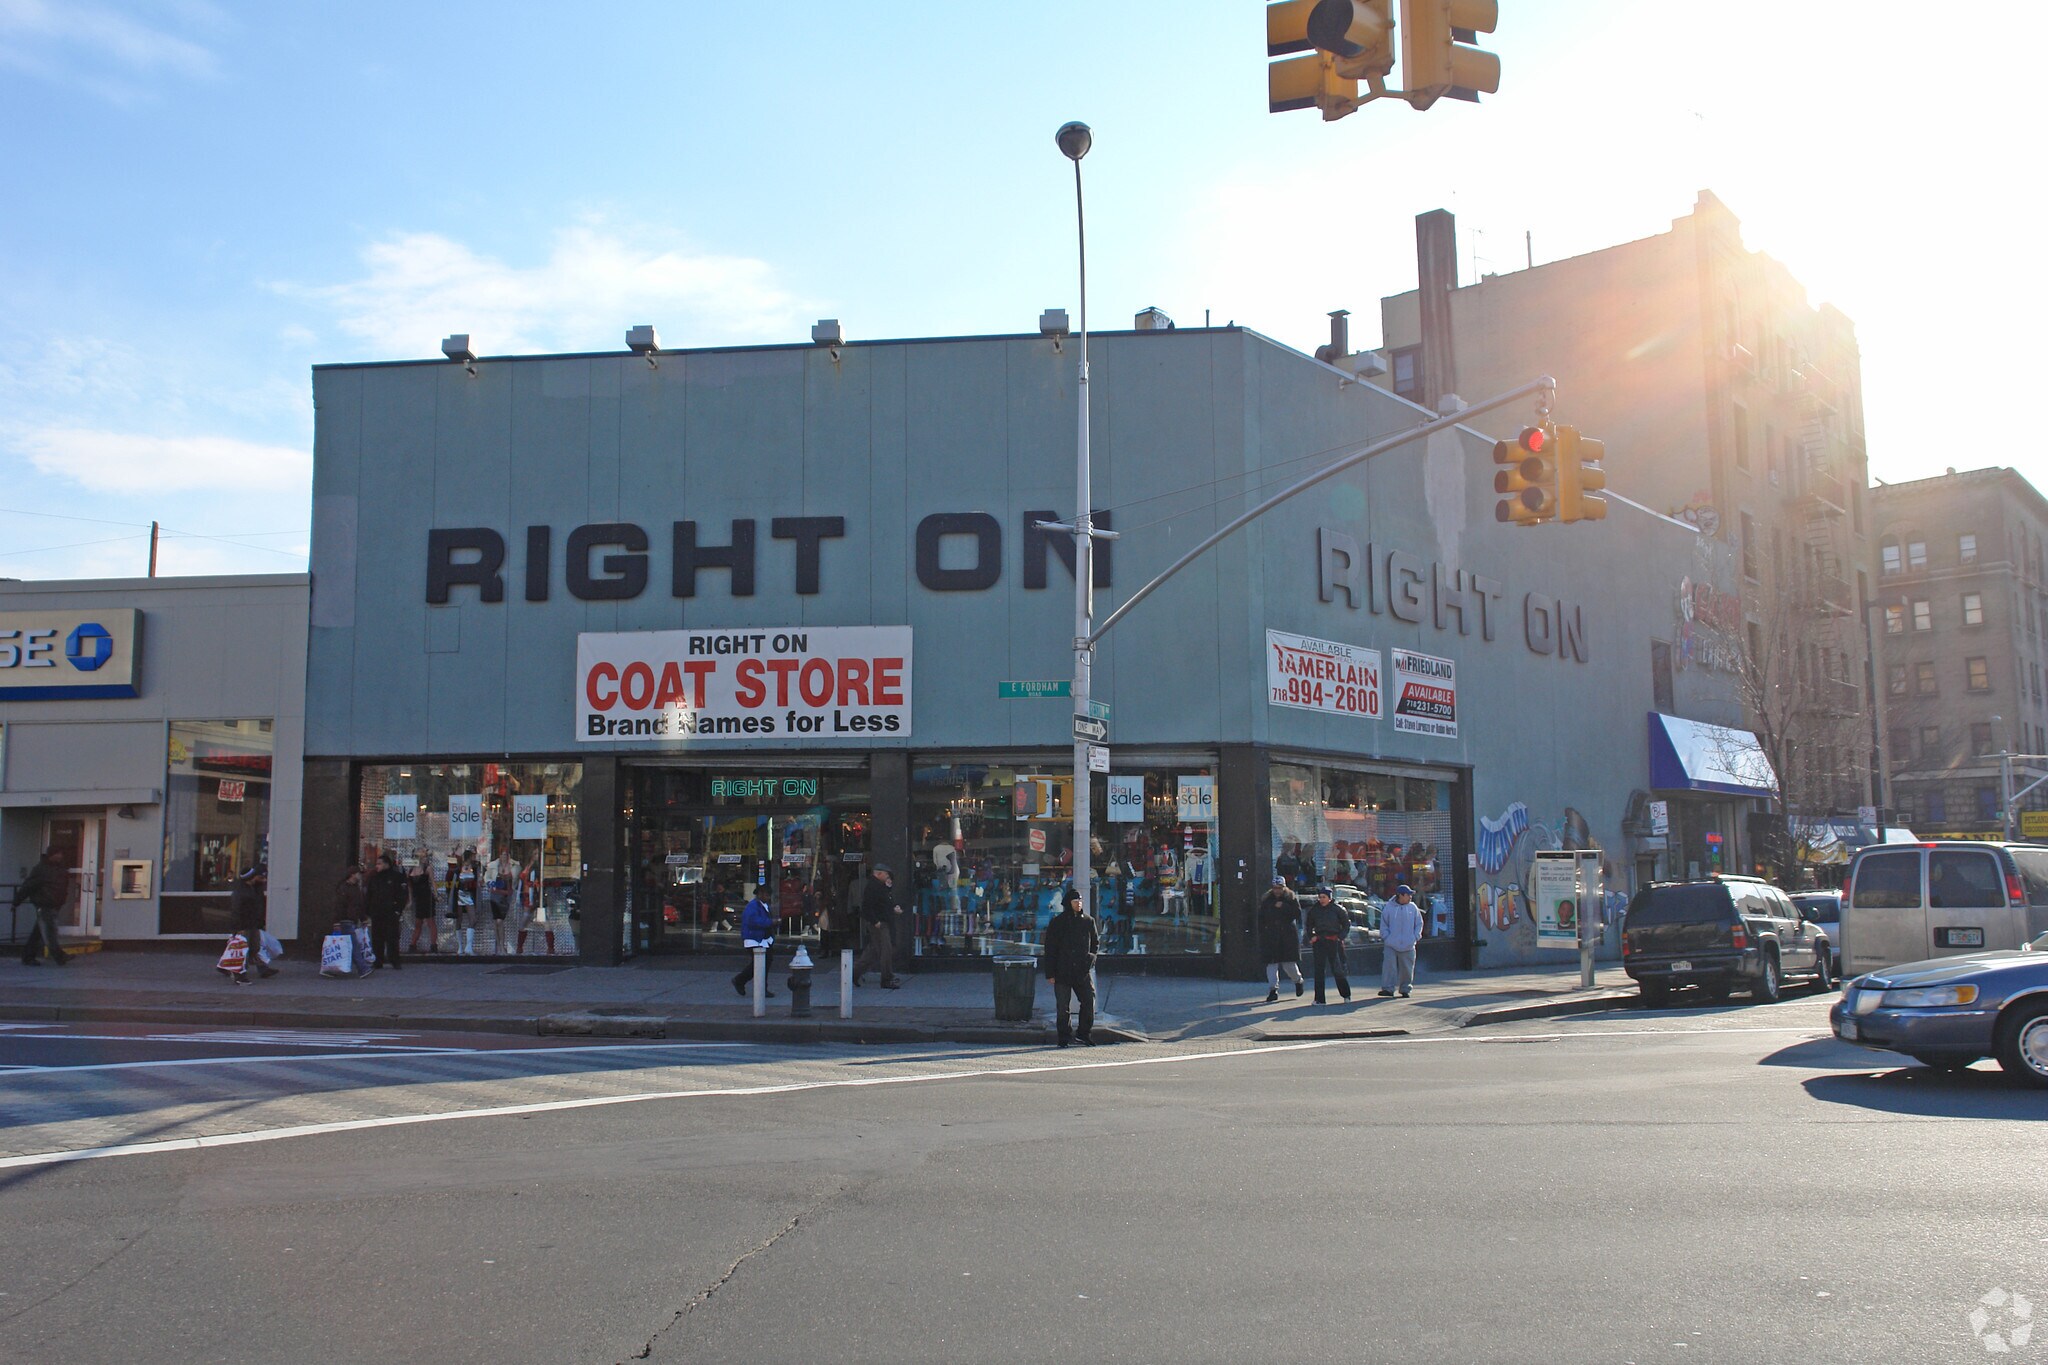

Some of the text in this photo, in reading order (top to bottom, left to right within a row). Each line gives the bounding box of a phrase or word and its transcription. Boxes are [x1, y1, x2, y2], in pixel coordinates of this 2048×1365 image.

[425, 510, 1111, 604] RIGHT ON
[1318, 527, 1502, 642] RIGHT
[1525, 591, 1589, 664] ON
[689, 633, 808, 655] RIGHT ON
[1300, 639, 1352, 659] AVAILABLE
[1273, 643, 1378, 689] TAMERLAIN
[1407, 656, 1452, 679] FRIEDLAND
[586, 657, 904, 712] COAT STORE
[1012, 682, 1059, 692] E FORDHAM
[1407, 684, 1452, 703] AVAILABLE
[1272, 677, 1379, 715] 718 994-2600
[1406, 699, 1416, 708] 718
[1416, 700, 1452, 716] 231-5700
[588, 709, 900, 736] Brand Names for Less
[1077, 721, 1103, 735] ONE WAY
[711, 779, 817, 797] RIGHT ON
[1110, 785, 1127, 795] big
[1110, 787, 1142, 806] sale
[1180, 785, 1197, 795] big
[1180, 787, 1212, 806] sale
[386, 806, 415, 823] sale
[387, 803, 401, 814] big
[451, 803, 467, 814] big
[451, 806, 480, 823] sale
[516, 803, 532, 814] big
[516, 806, 545, 824] sale
[322, 952, 343, 966] STAR
